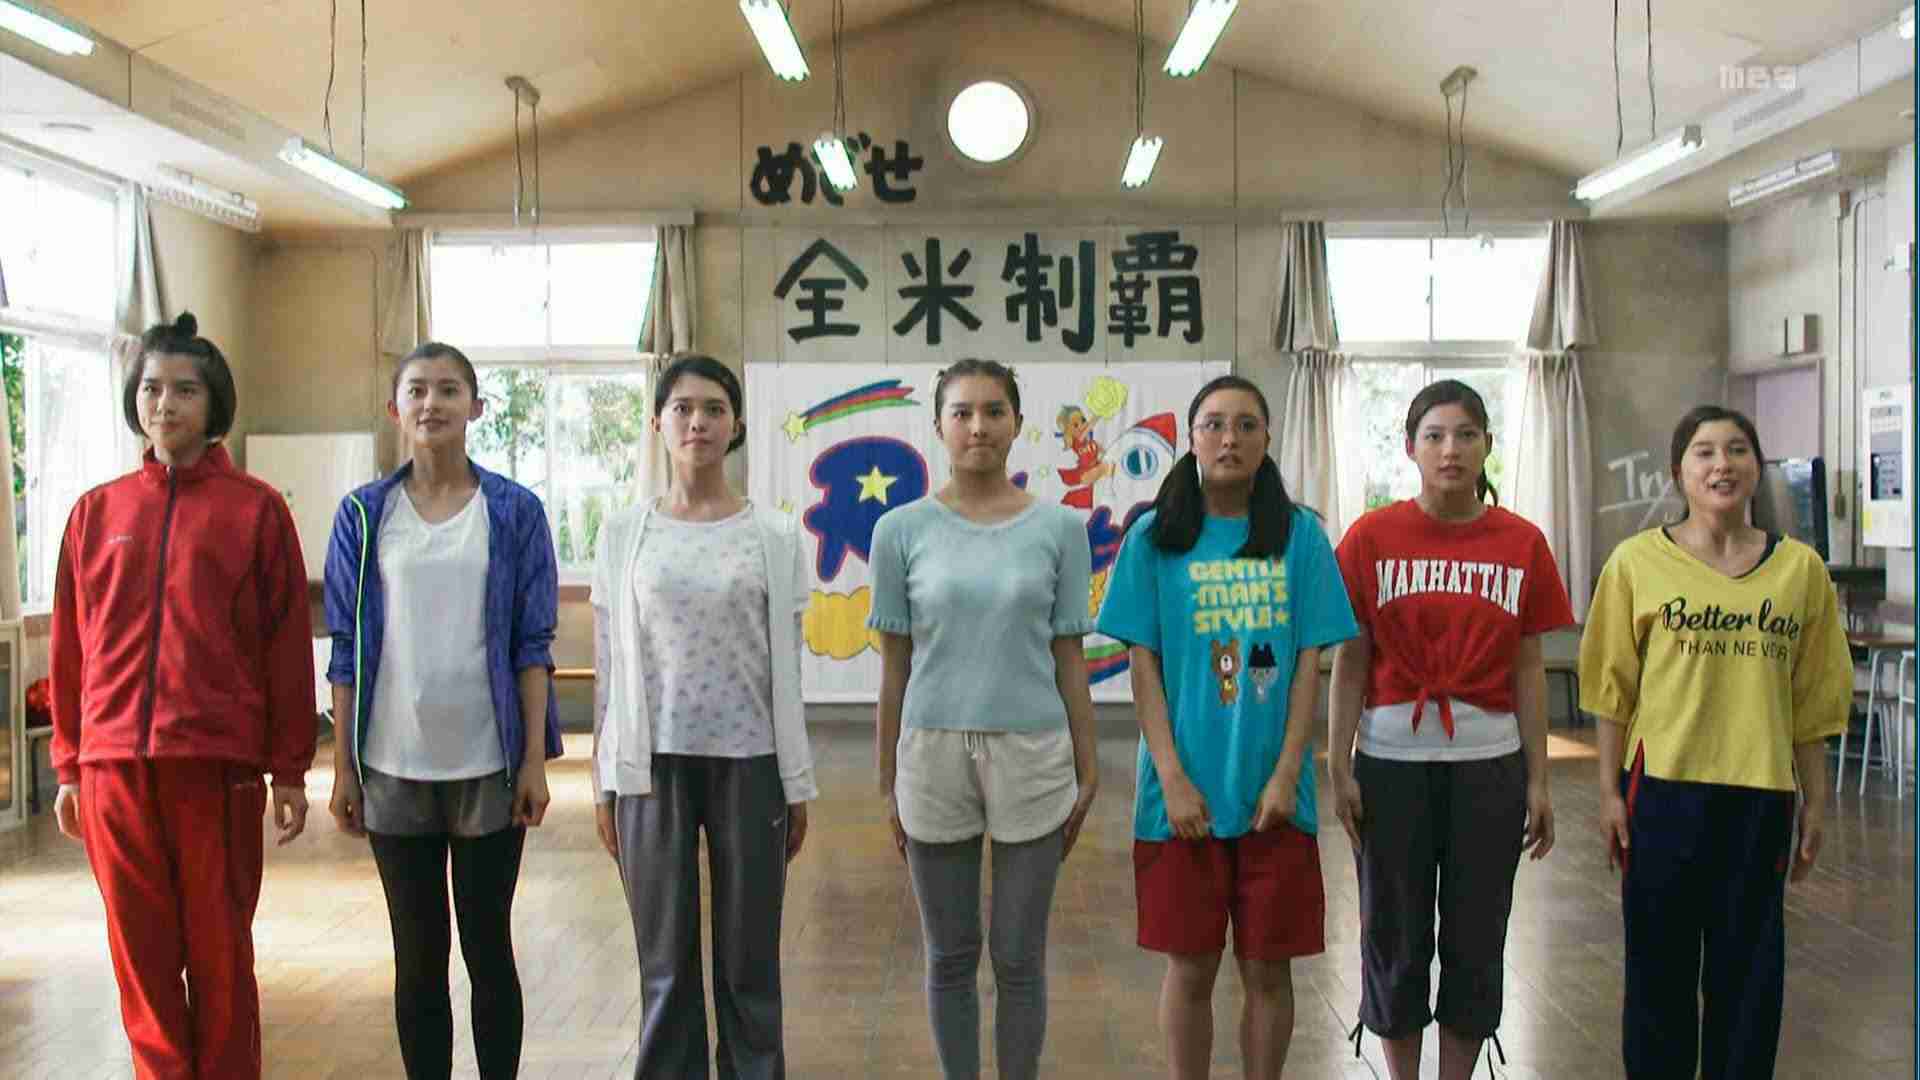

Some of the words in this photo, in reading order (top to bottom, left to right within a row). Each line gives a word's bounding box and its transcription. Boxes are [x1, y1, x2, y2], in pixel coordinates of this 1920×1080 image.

[773, 231, 1205, 353] 全米制覇
[1375, 559, 1525, 617] MANHATTAN
[1658, 596, 1753, 632] Better
[1678, 639, 1727, 657] THAN
